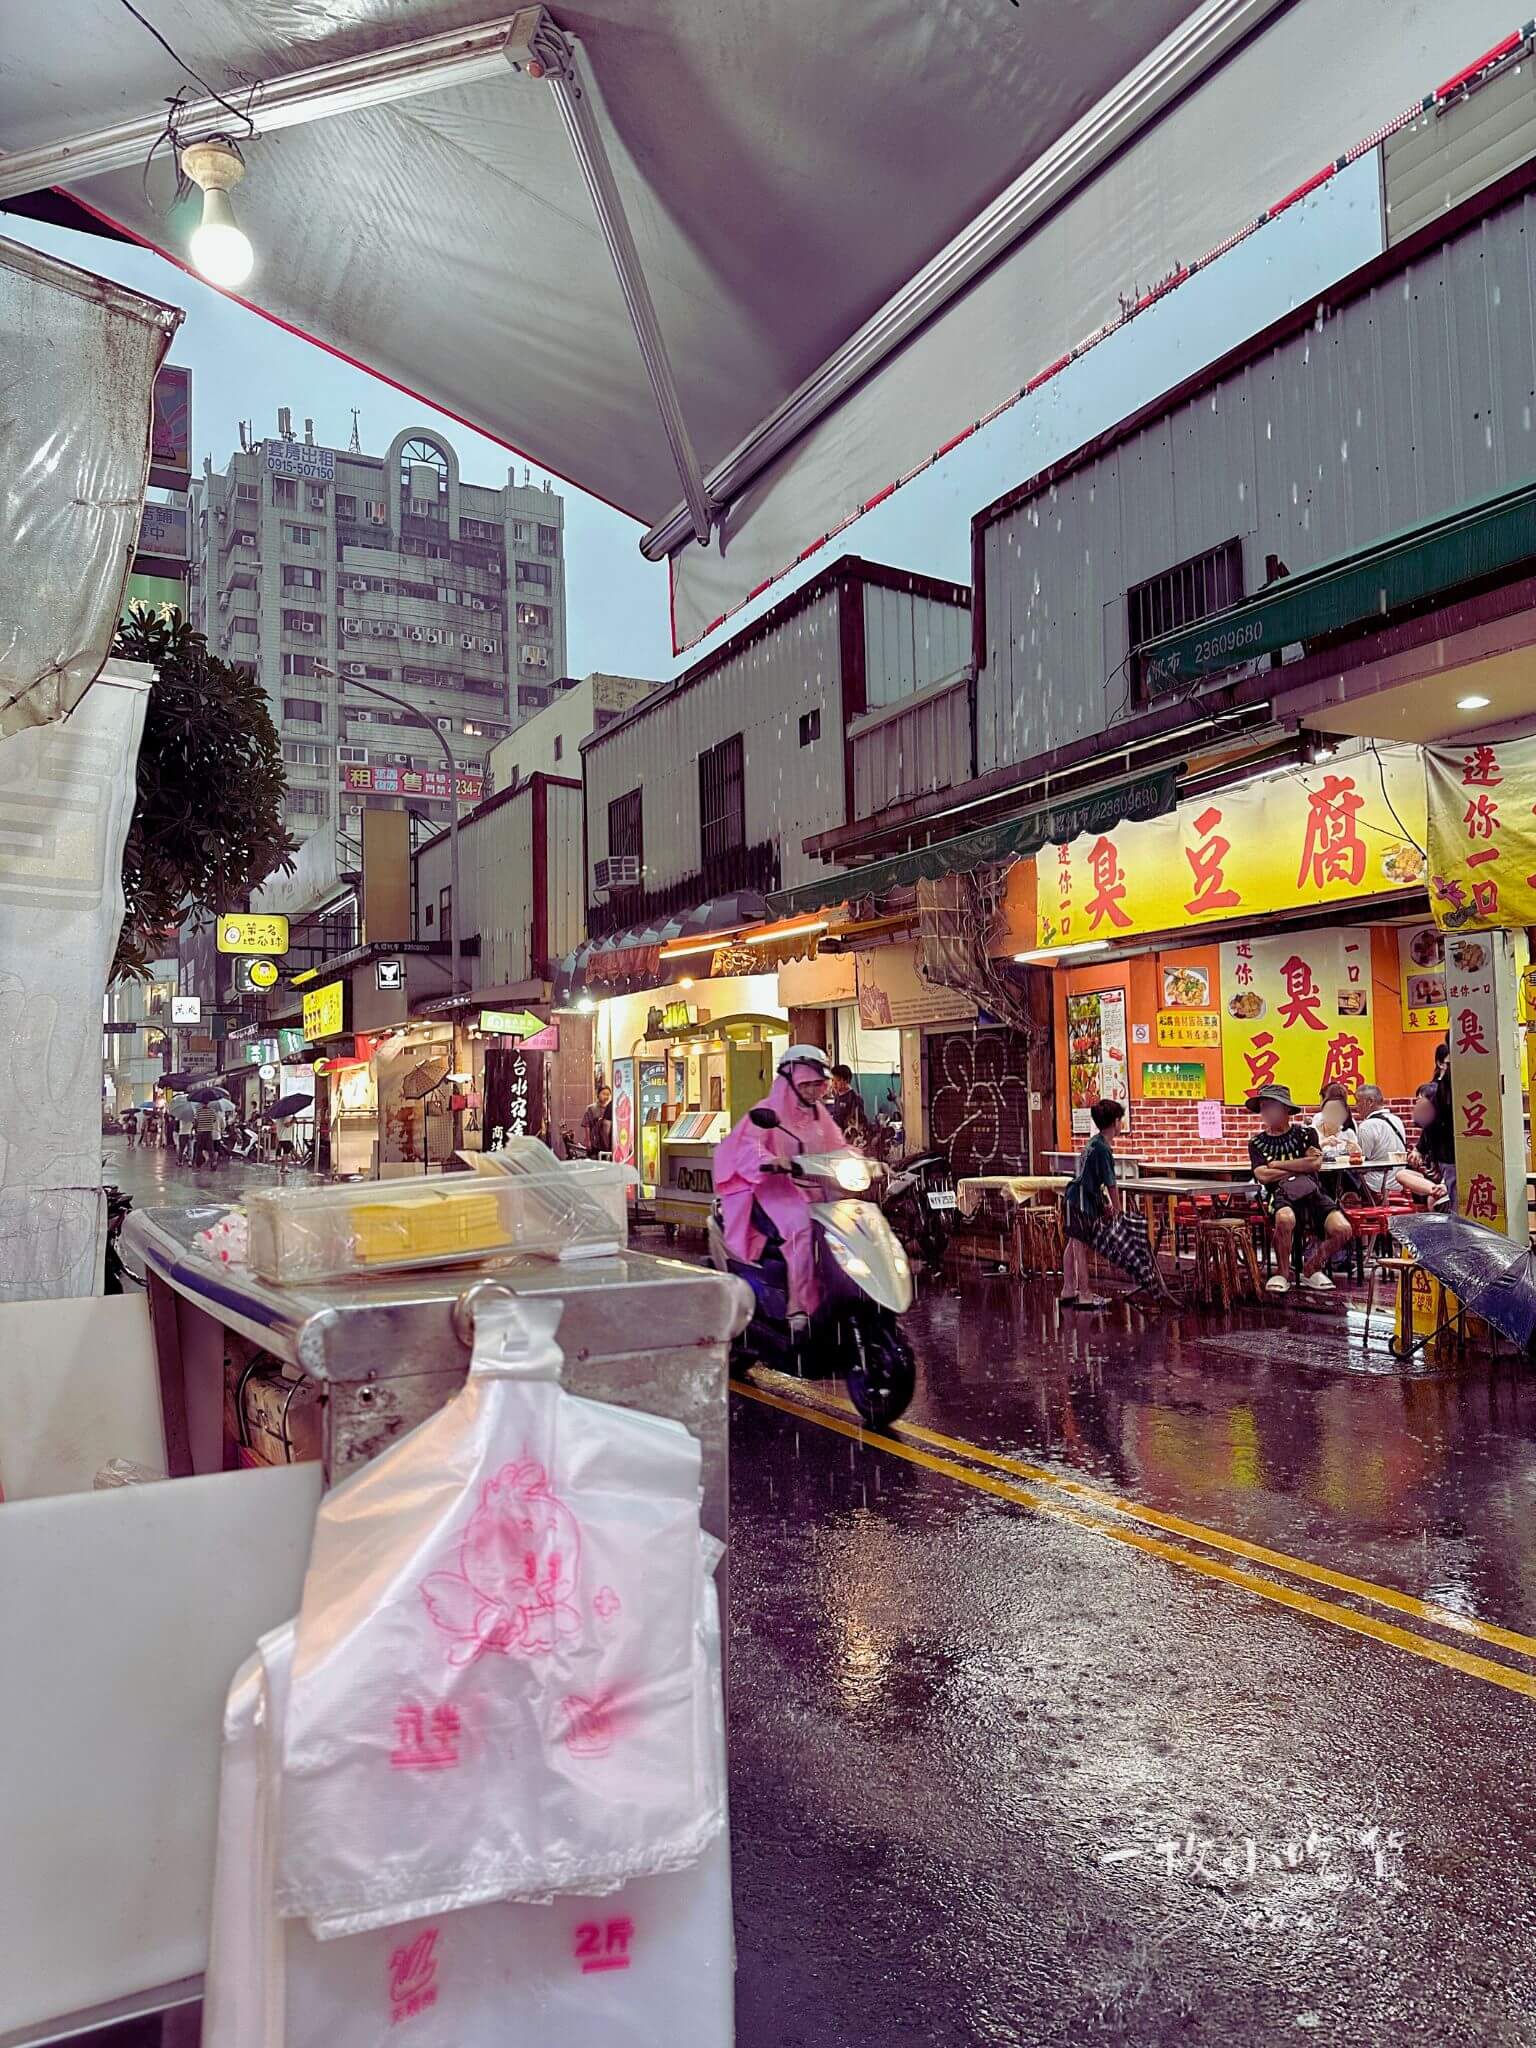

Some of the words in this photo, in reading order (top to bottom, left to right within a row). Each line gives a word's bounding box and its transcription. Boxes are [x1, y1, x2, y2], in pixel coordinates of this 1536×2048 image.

[267, 457, 334, 480] 0915-507150
[268, 440, 334, 467] 套房出租
[1194, 620, 1264, 665] 23609680
[350, 768, 373, 788] 租
[401, 771, 423, 792] 售
[1462, 745, 1505, 915] 迷你一口
[1085, 775, 1367, 932] 臭豆腐
[1057, 842, 1073, 936] 迷你一口
[243, 935, 284, 947] 地瓜球
[246, 922, 276, 936] 第一名
[1235, 942, 1254, 986] 迷你
[1344, 943, 1361, 983] 一口
[1276, 955, 1329, 1031] 臭
[1449, 984, 1491, 998] 迷你一口
[1408, 1010, 1449, 1028] 臭豆
[1243, 1031, 1366, 1101] 豆腐
[1455, 1008, 1498, 1222] 臭豆腐
[574, 1915, 635, 1958] 2斤
